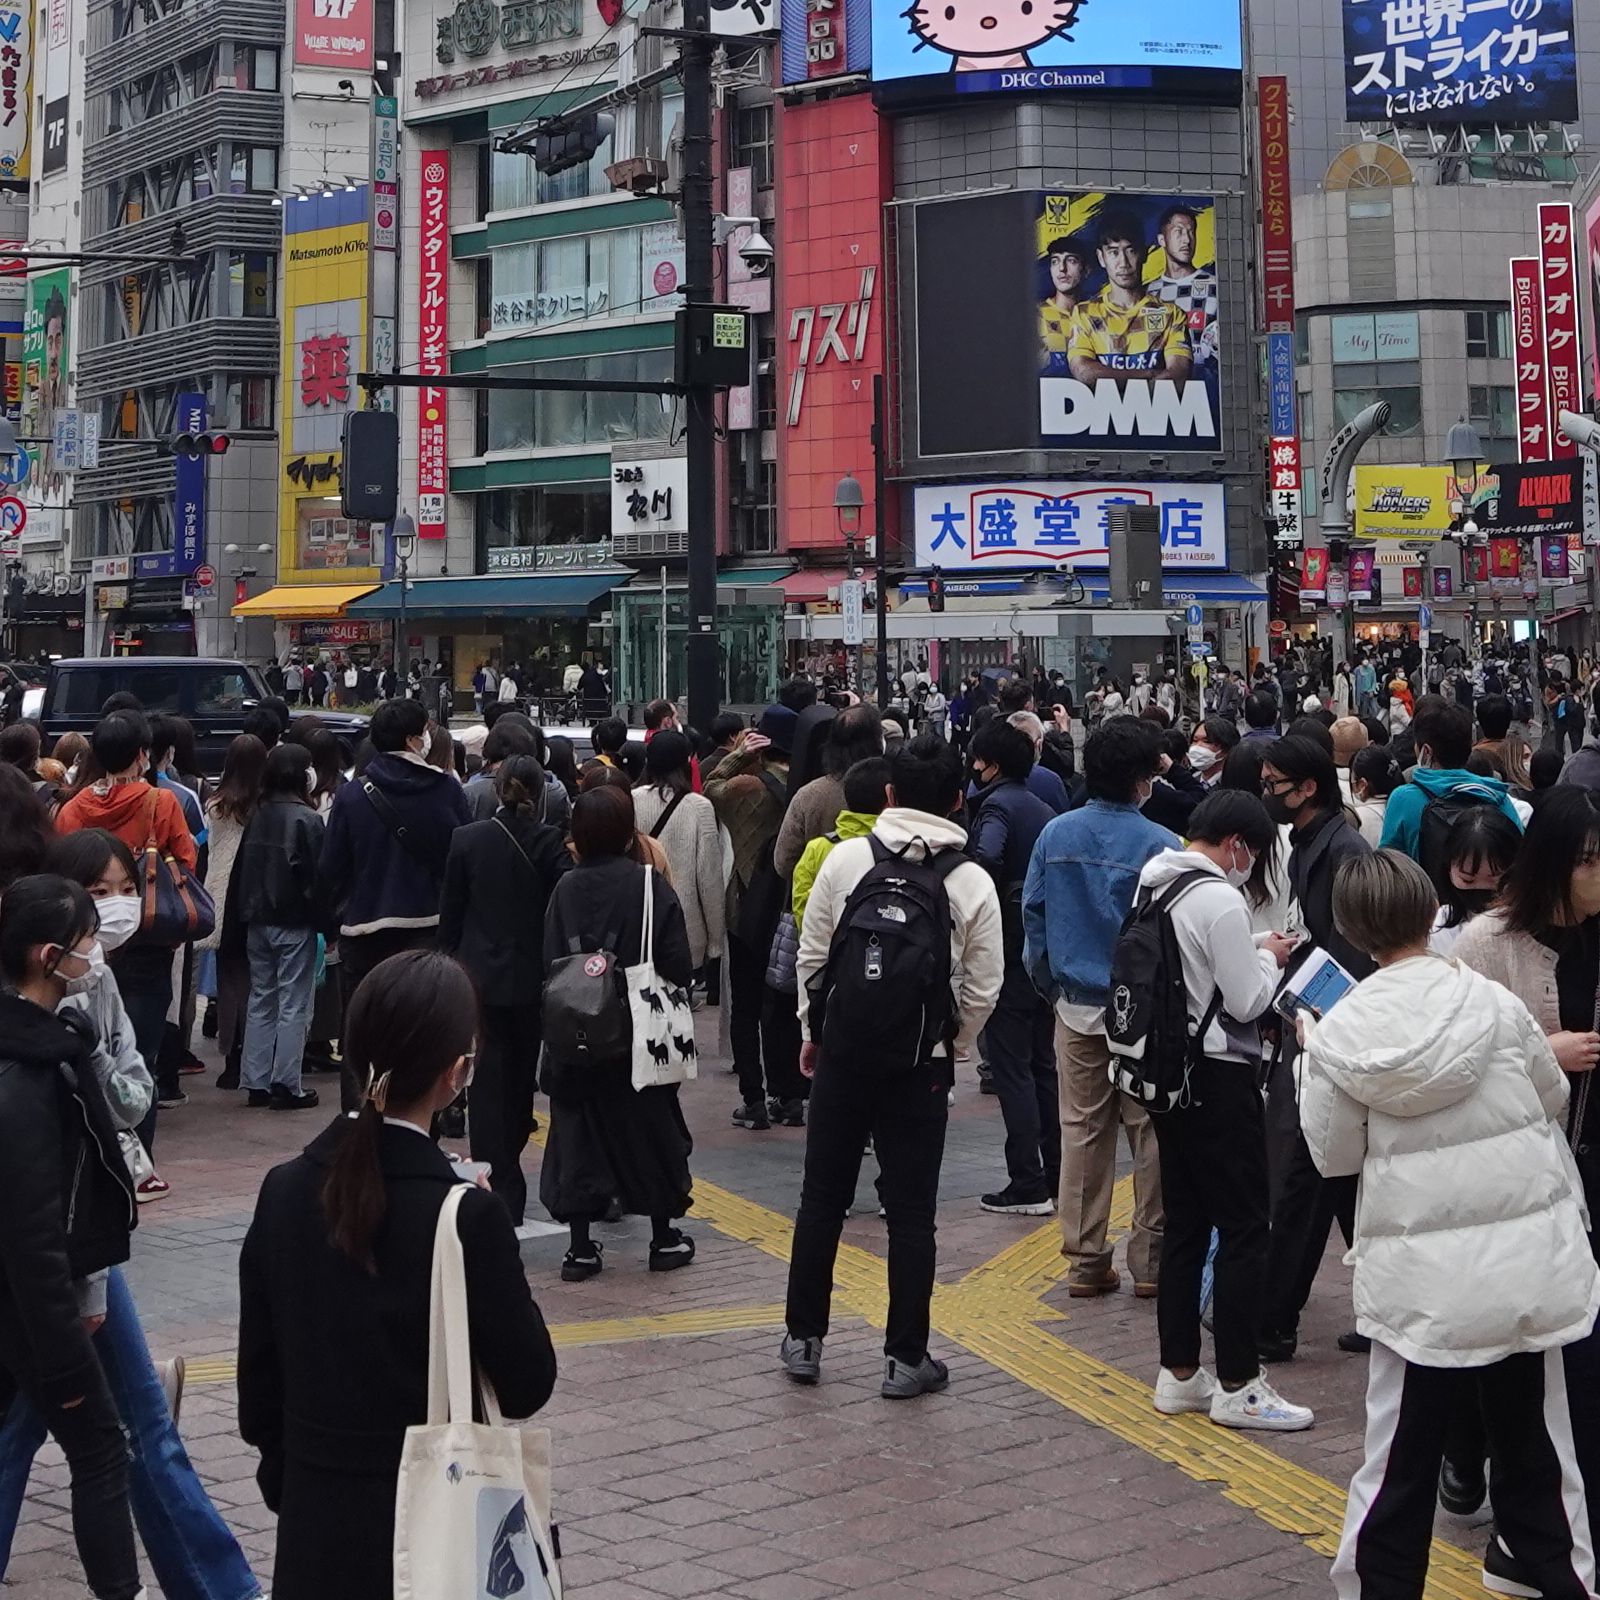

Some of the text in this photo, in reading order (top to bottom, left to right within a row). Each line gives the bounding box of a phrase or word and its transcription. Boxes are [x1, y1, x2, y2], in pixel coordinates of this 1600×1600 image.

[1000, 70, 1106, 89] DHC Channel
[1350, 22, 1570, 95] ストライカー
[1385, 73, 1536, 118] にはなれない。
[47, 117, 65, 149] 7F
[1264, 83, 1288, 238] クスリのことなら
[289, 244, 343, 262] Matsumoto
[1543, 220, 1575, 352] カラオケ
[301, 332, 350, 407] 薬
[1039, 377, 1216, 438] DMM
[63, 412, 78, 467] 渋谷駅前
[1518, 474, 1572, 508] ALVARK
[183, 502, 196, 561] みずほ銀行
[333, 621, 359, 640] SALE
